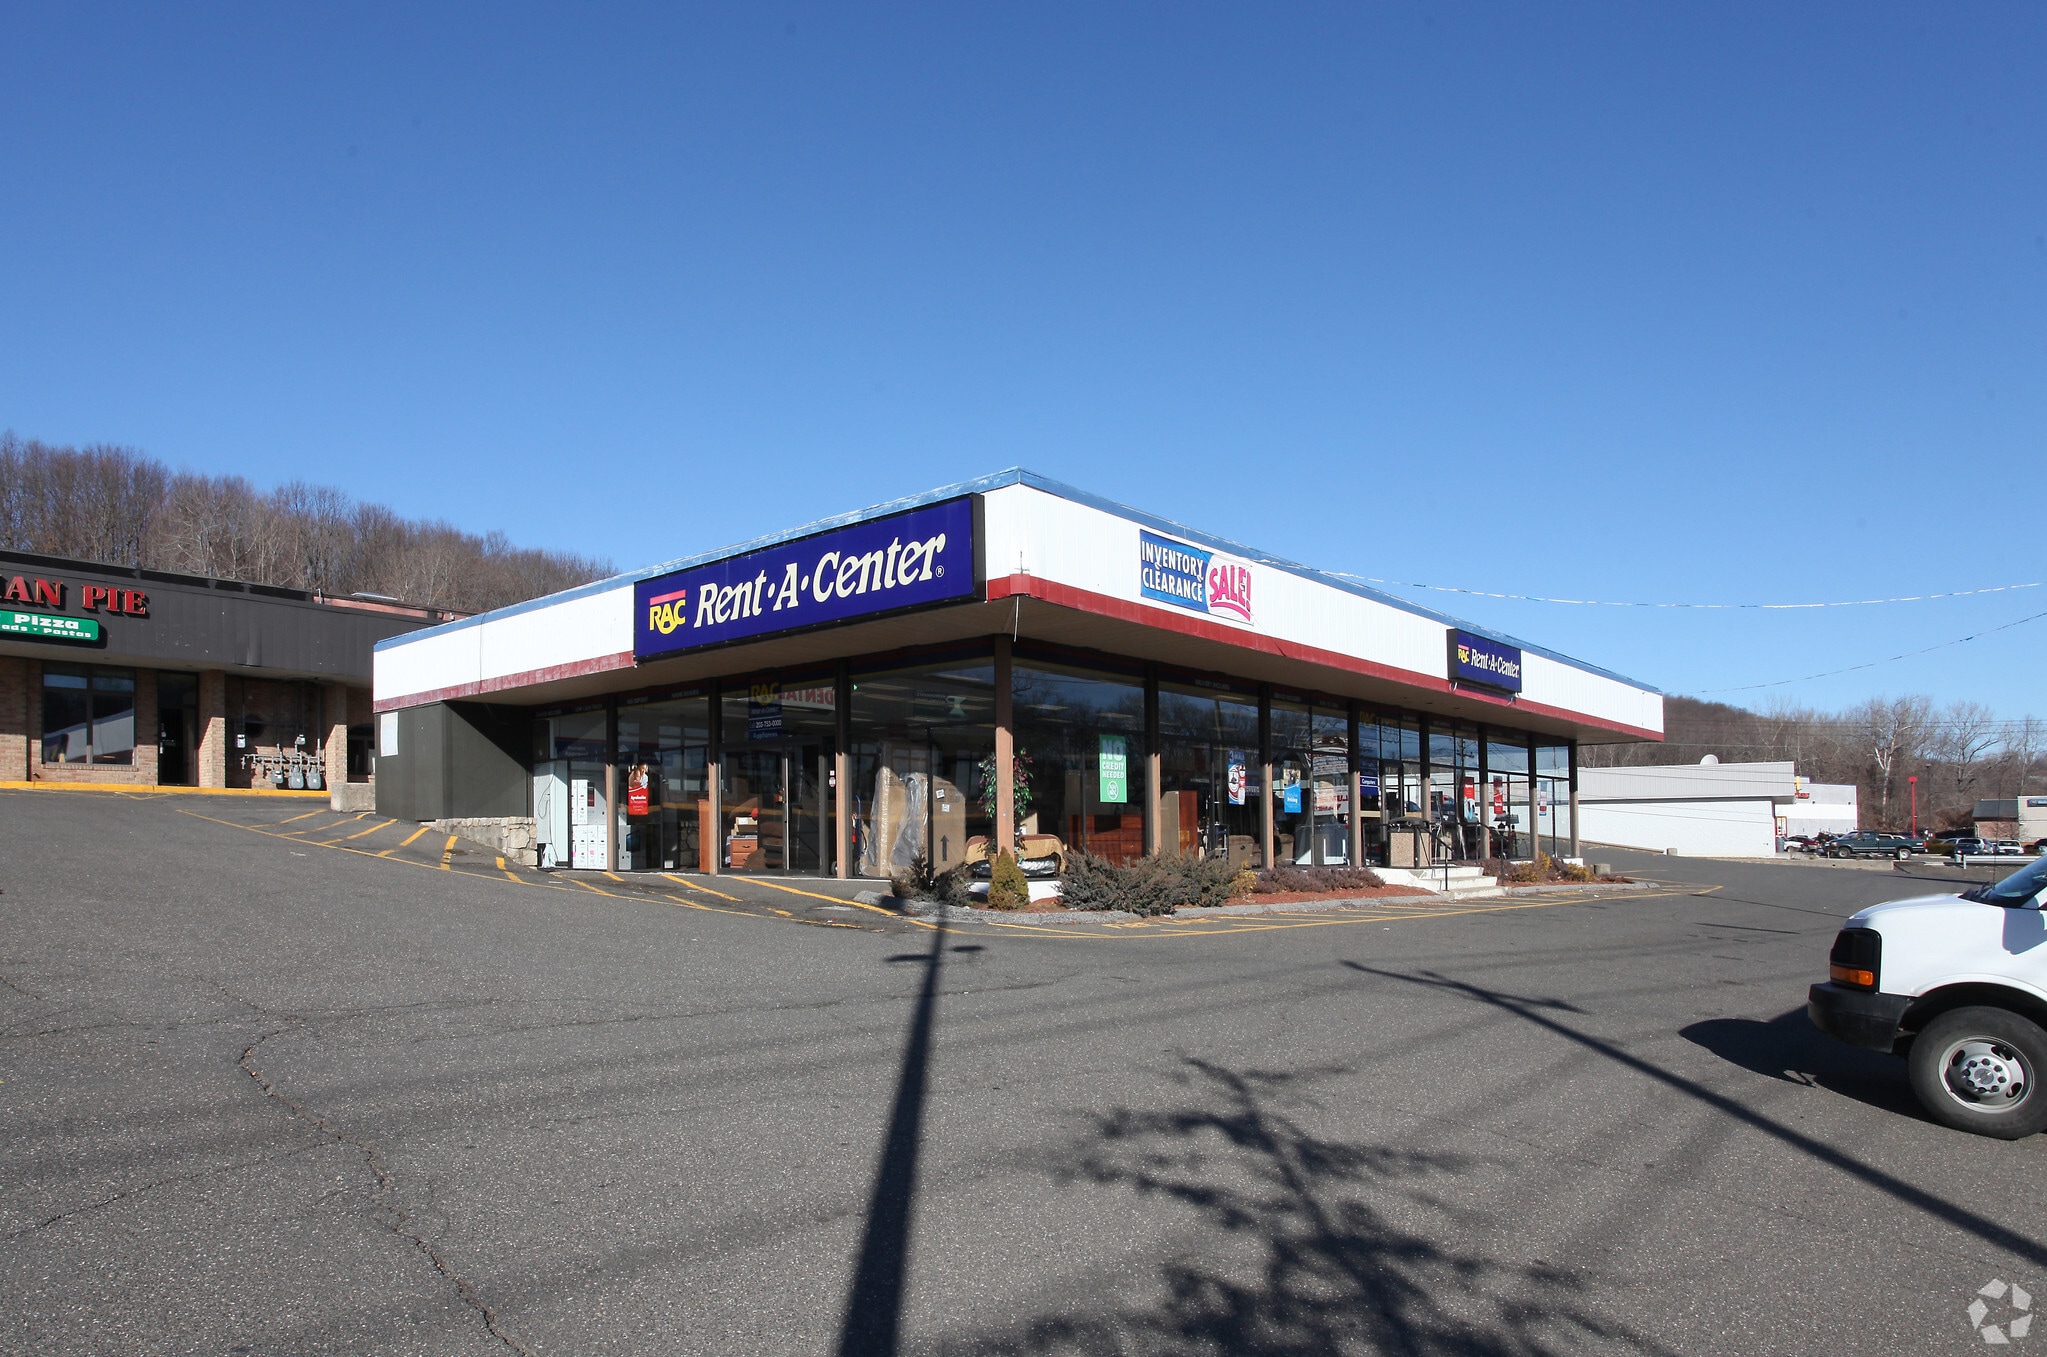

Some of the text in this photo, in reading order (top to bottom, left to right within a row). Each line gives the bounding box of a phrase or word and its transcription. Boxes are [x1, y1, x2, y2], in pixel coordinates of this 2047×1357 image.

[1141, 541, 1204, 582] INVENTORY
[0, 575, 146, 615] AN PIE
[1142, 567, 1203, 603] CLEARANCE
[1209, 565, 1252, 613] SALE!
[14, 614, 80, 630] Pizza
[650, 600, 686, 635] RAC
[1, 624, 92, 638] ads Pastas
[1457, 648, 1470, 664] RAC
[1102, 740, 1124, 761] NO
[1102, 762, 1125, 771] CREDIT
[1102, 770, 1125, 779] NEEDED
